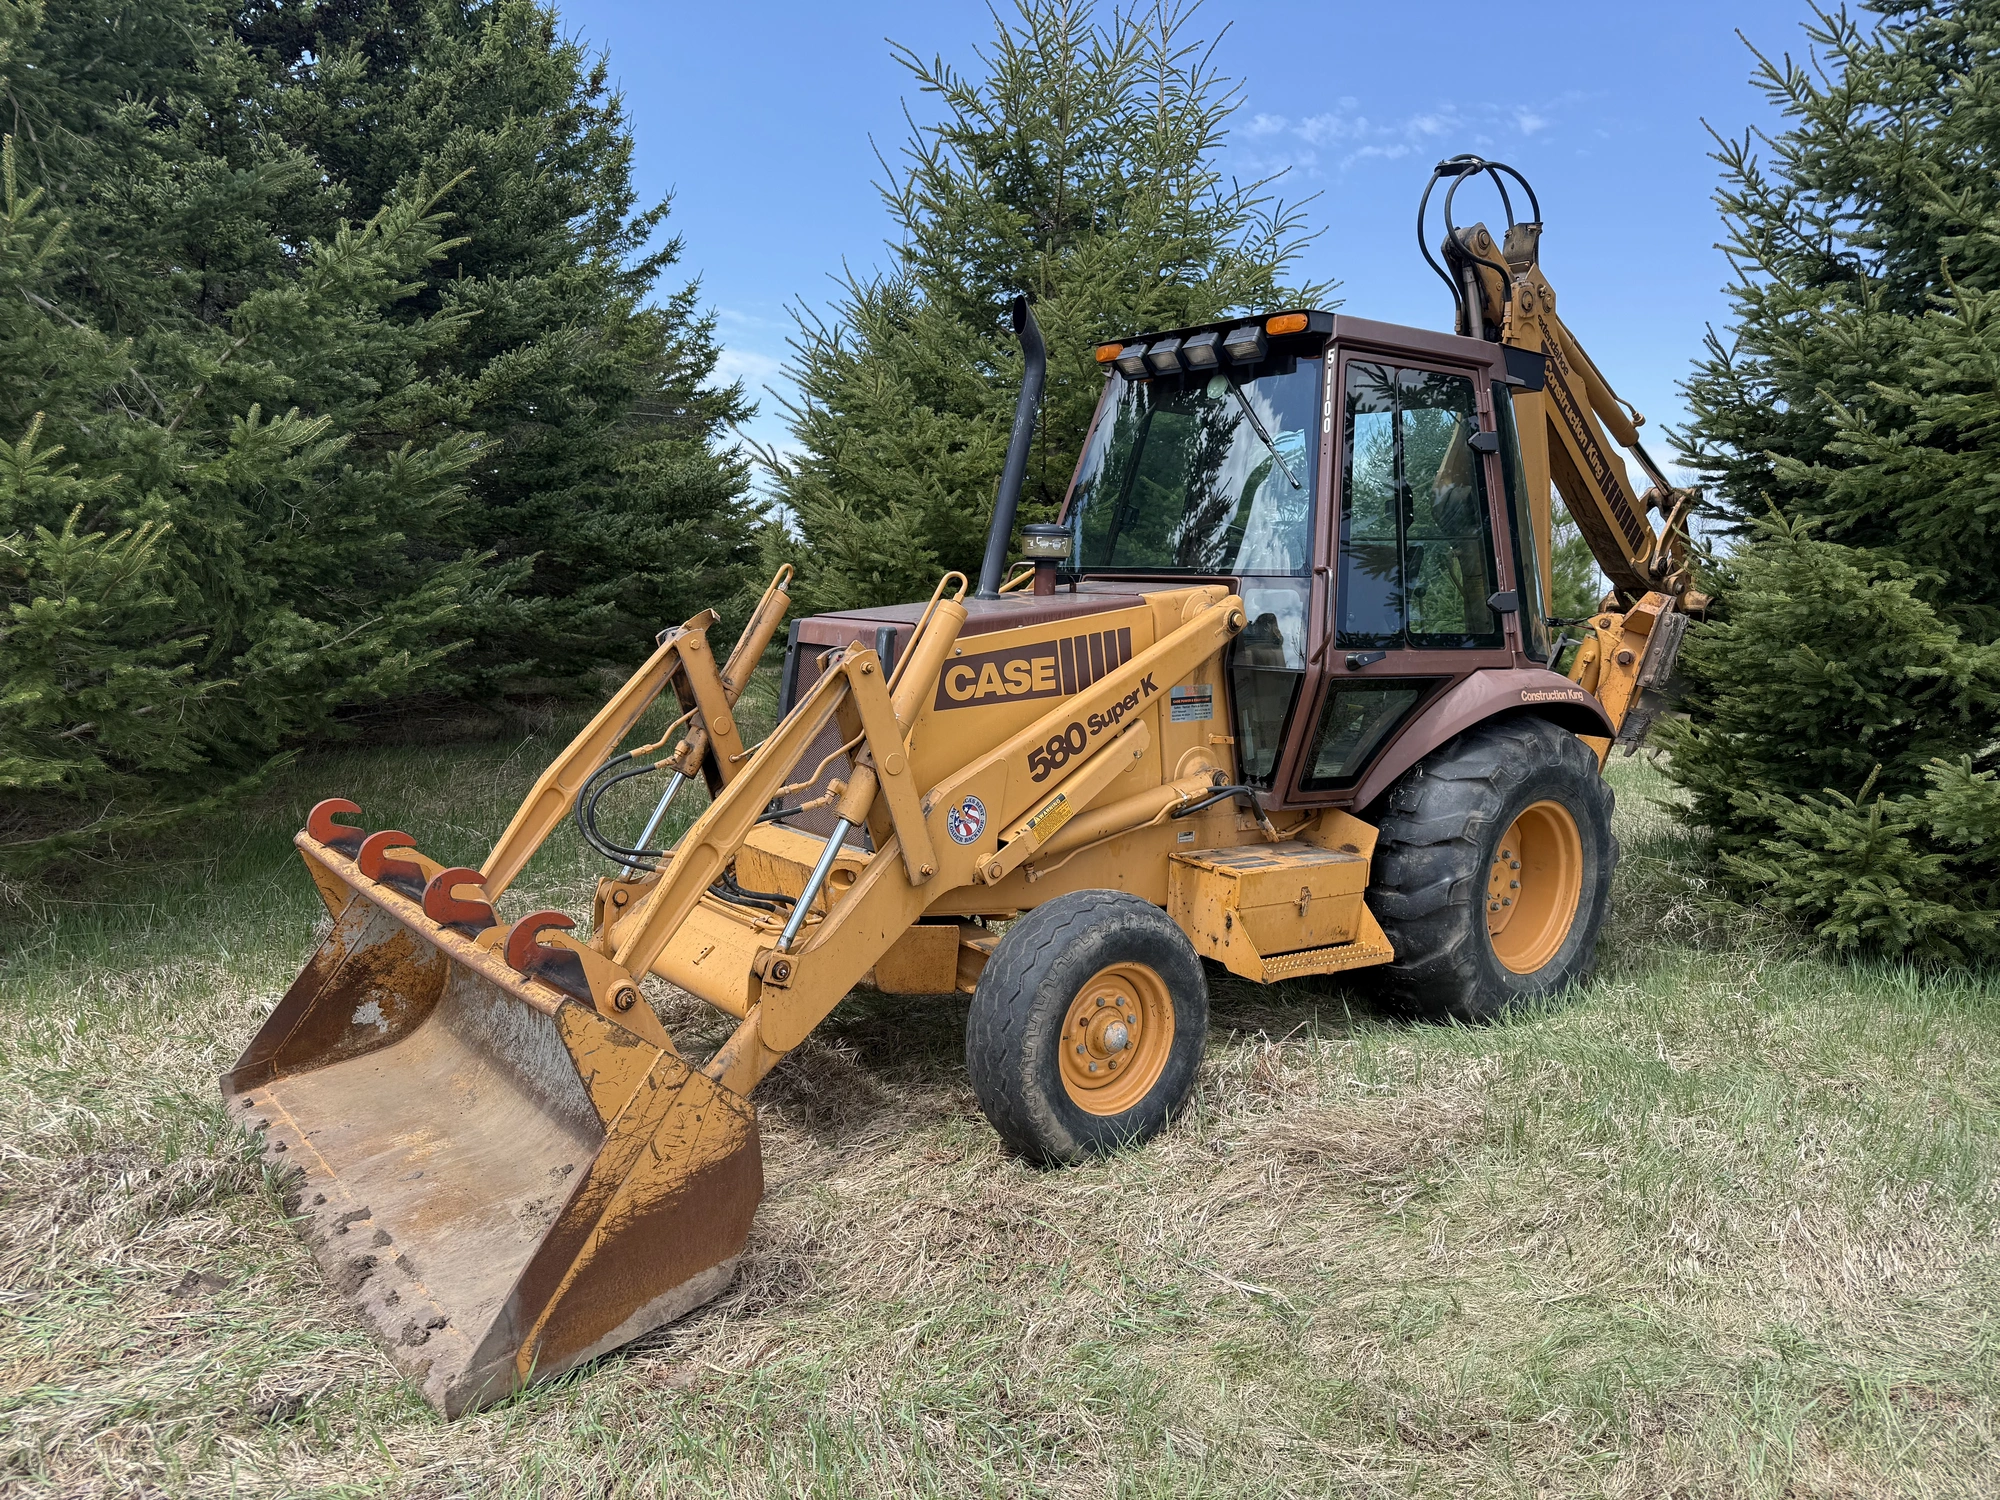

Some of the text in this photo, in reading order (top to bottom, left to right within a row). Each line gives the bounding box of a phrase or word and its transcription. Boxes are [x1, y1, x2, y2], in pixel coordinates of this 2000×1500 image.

[1538, 314, 1569, 376] extendahoe
[1544, 360, 1605, 480] Construction King
[945, 656, 1056, 701] CASE
[1521, 689, 1584, 702] Construction King
[1027, 671, 1159, 783] 580 Super K
[1038, 798, 1061, 820] WARNING
